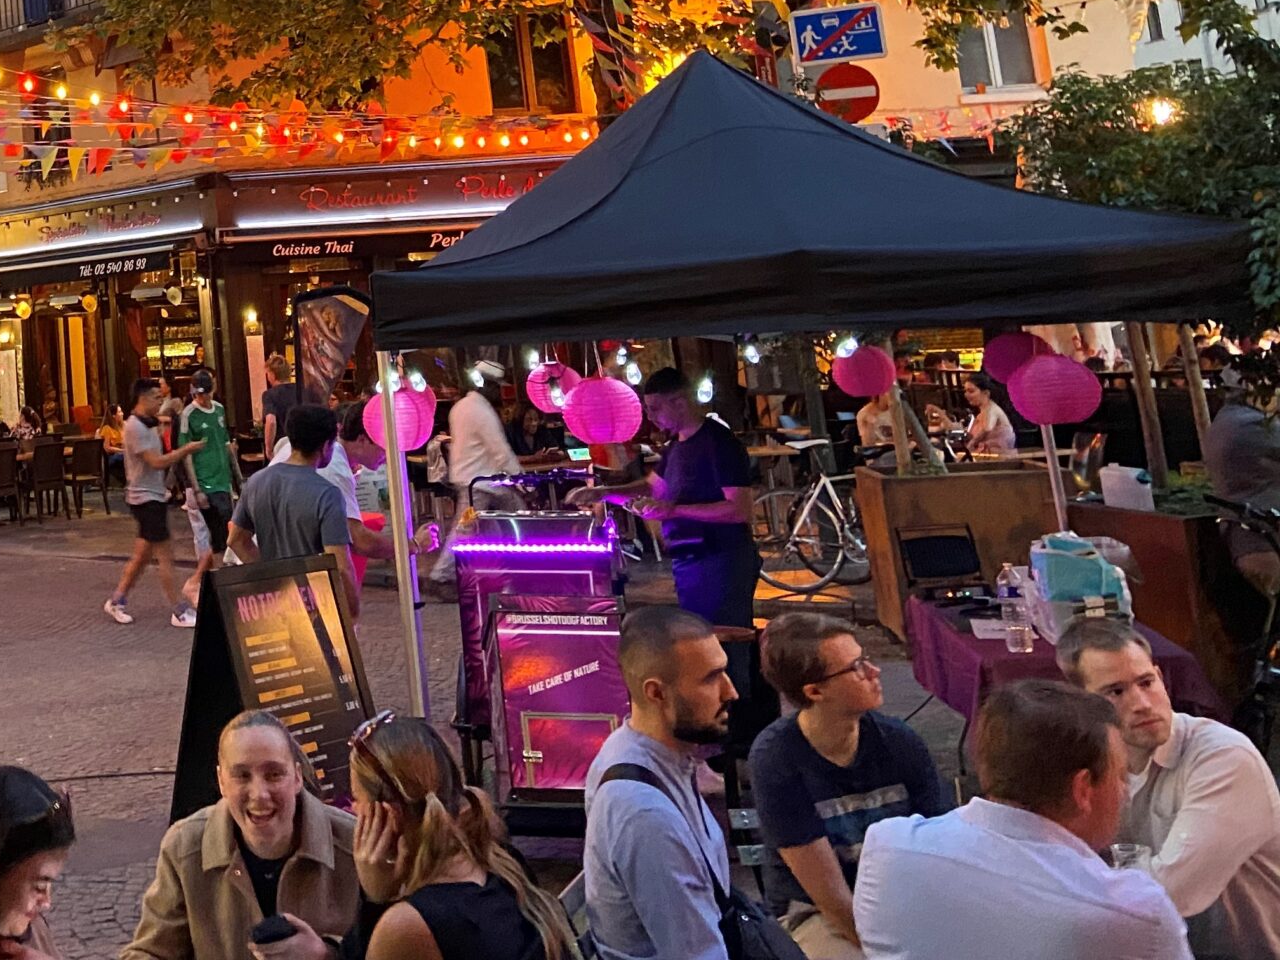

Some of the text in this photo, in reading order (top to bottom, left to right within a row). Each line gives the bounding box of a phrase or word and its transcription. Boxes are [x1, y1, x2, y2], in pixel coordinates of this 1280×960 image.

[300, 186, 418, 212] Restaurant
[455, 175, 518, 201] Perle
[272, 240, 354, 256] Cuisine Thai
[429, 230, 465, 248] Perl
[94, 263, 105, 275] 02
[106, 261, 122, 274] 540
[124, 260, 134, 272] 86
[136, 258, 147, 270] 93
[527, 660, 600, 696] TAKE CARE OF NATURE
